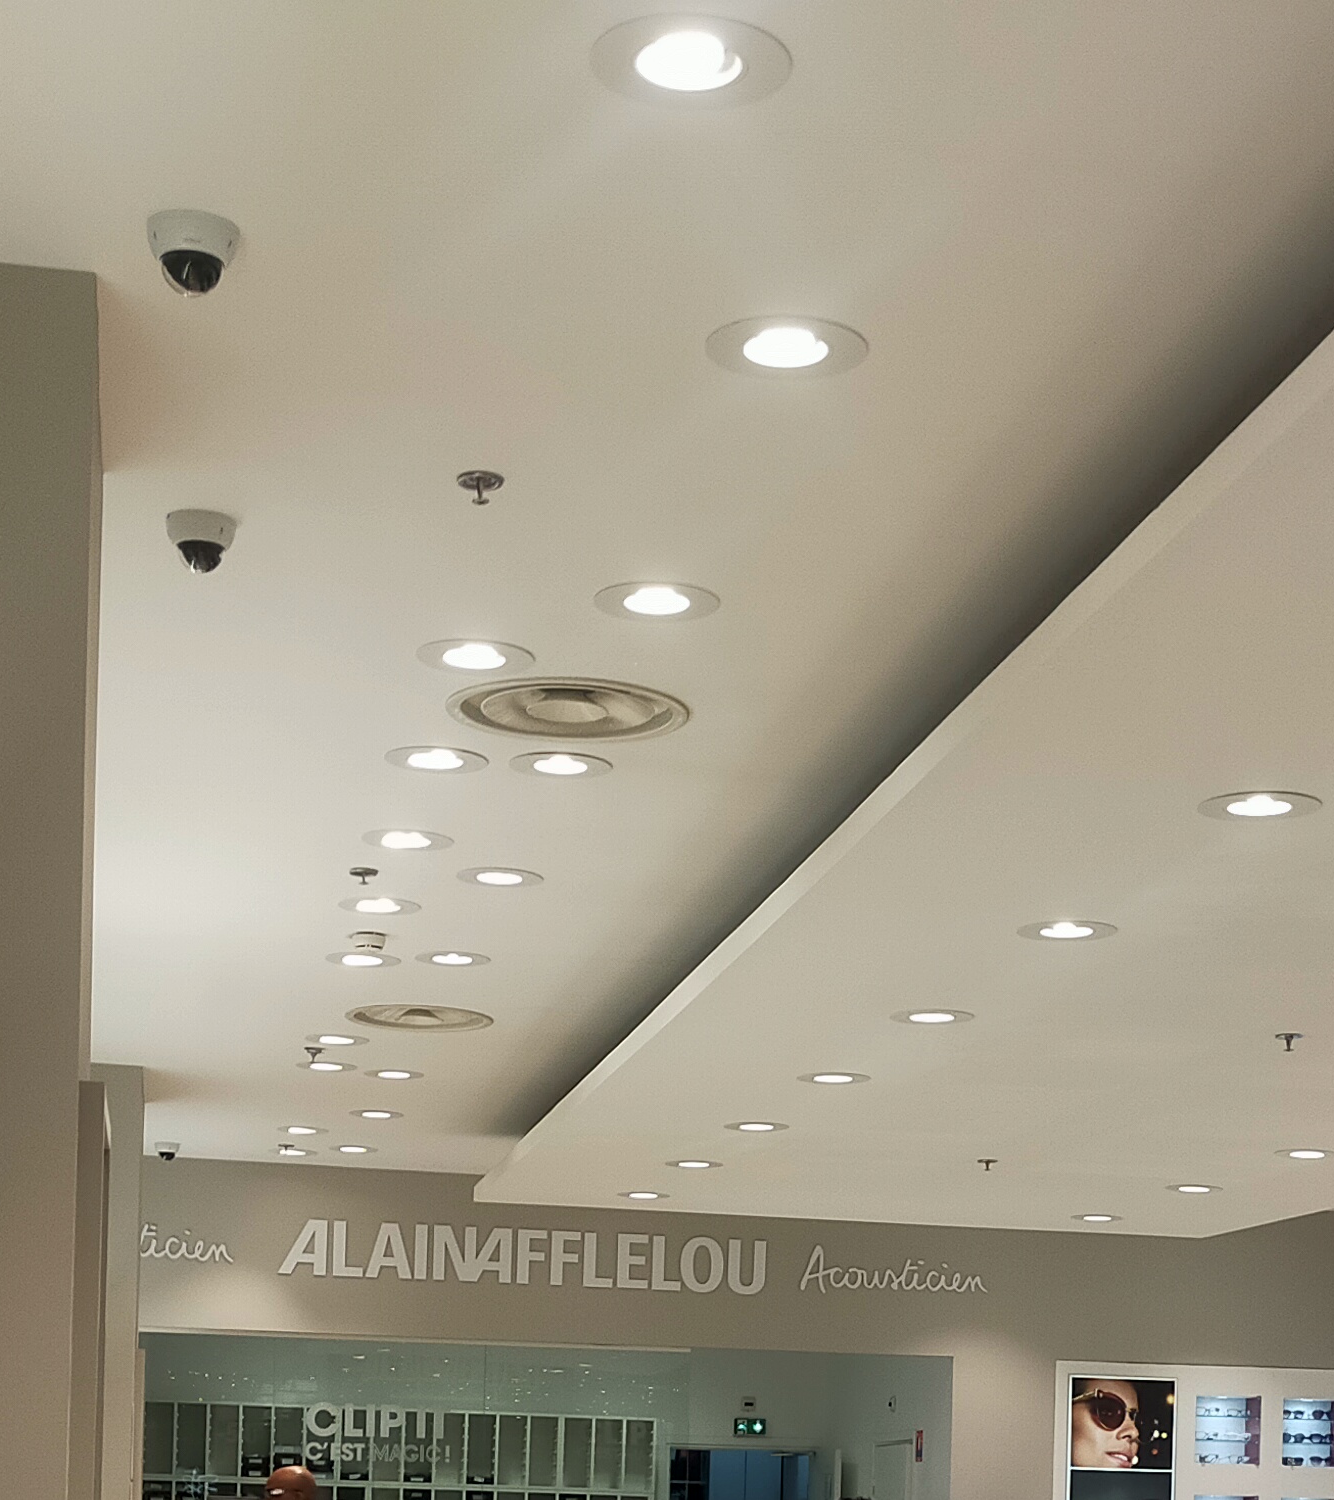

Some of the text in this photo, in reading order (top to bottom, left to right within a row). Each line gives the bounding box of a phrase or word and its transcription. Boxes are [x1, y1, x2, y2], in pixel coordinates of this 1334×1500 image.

[140, 1224, 233, 1263] ticien
[800, 1244, 988, 1294] Acousticien
[305, 1402, 407, 1437] CLIP
[305, 1441, 366, 1462] C'EST
